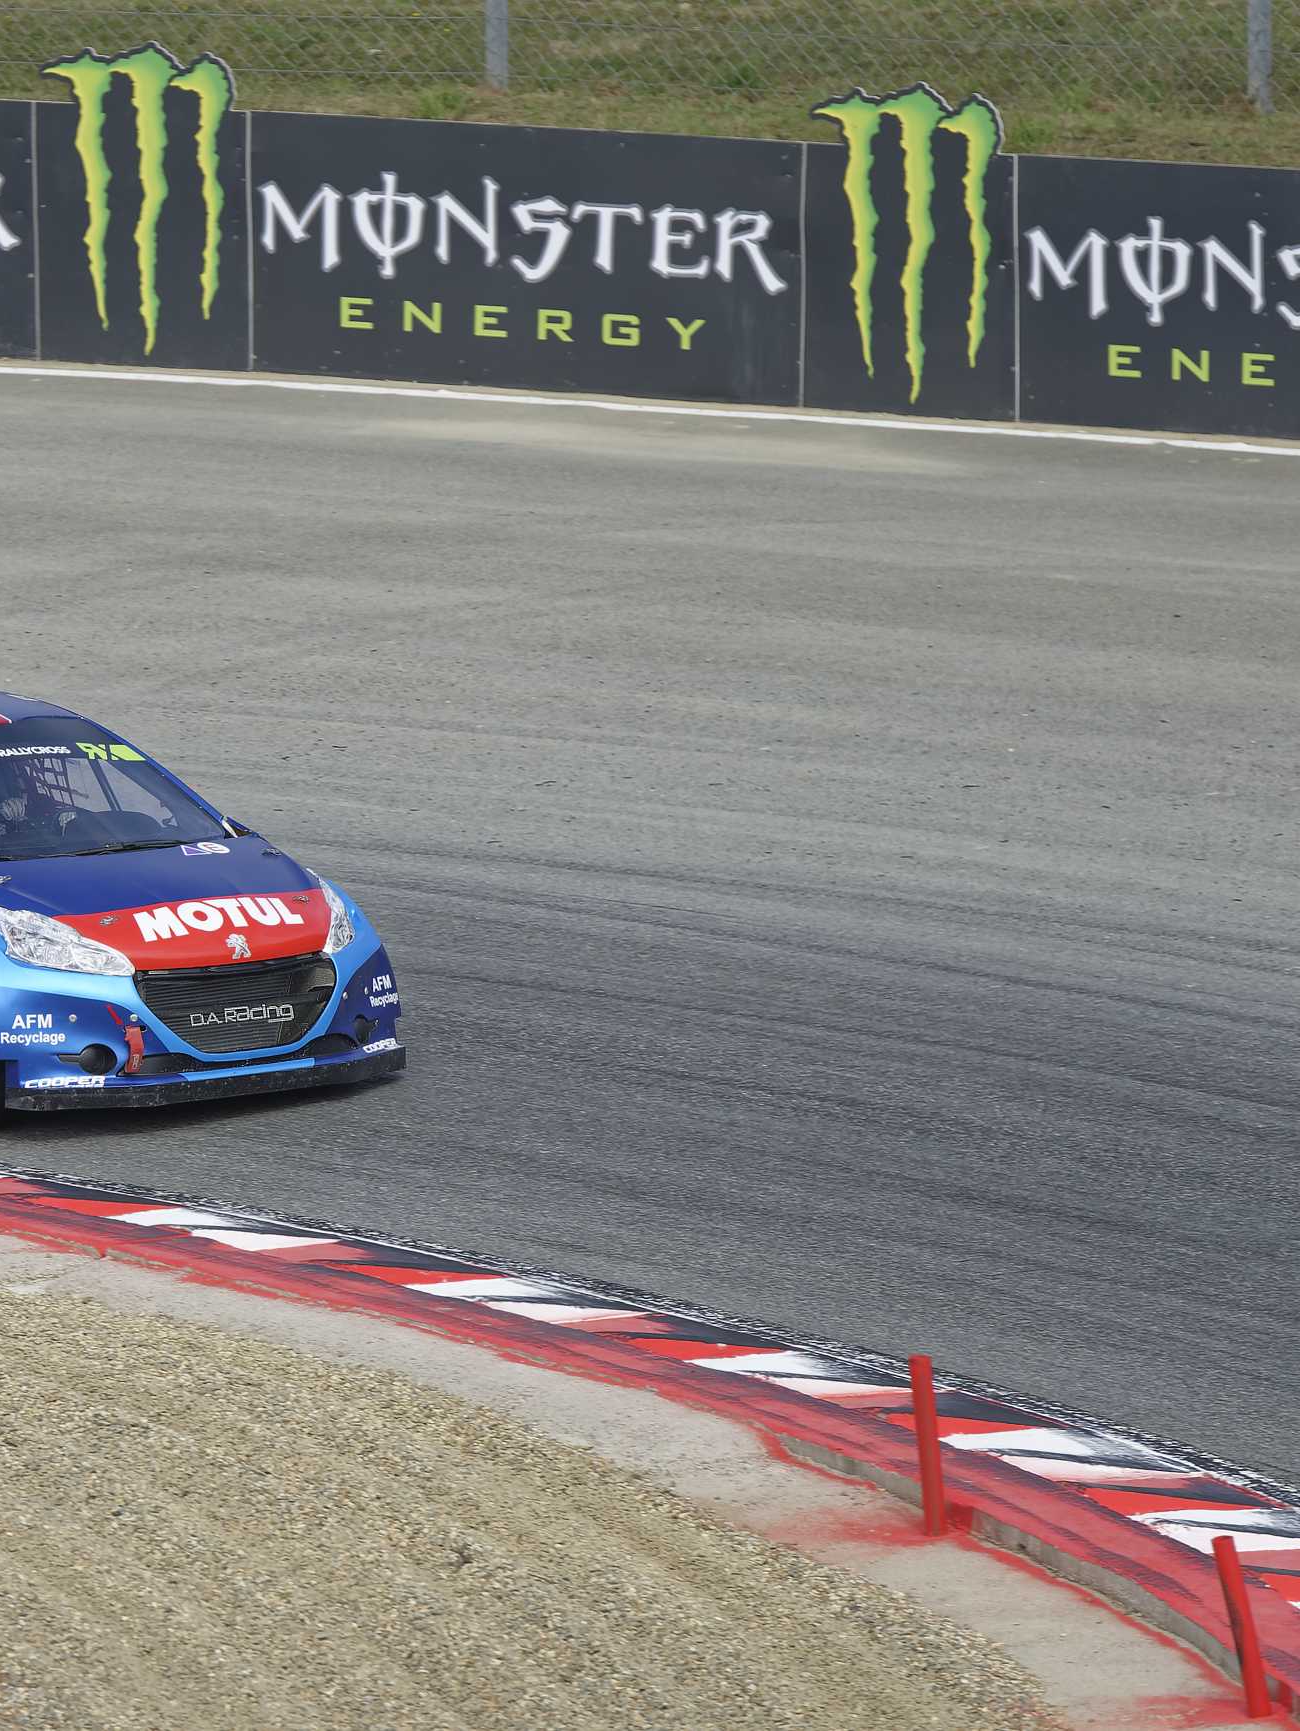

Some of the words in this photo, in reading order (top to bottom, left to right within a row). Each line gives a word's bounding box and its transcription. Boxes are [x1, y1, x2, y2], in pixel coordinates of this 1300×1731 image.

[257, 170, 788, 296] MONSTER
[339, 296, 707, 351] ENERGY
[133, 897, 304, 942] MOTUL
[372, 974, 392, 993] AFM
[368, 991, 399, 1008] Recyclage
[11, 1013, 53, 1029] AFM
[0, 1032, 66, 1046] Recyclage
[362, 1037, 398, 1053] COOPER
[24, 1075, 105, 1089] COOPER
